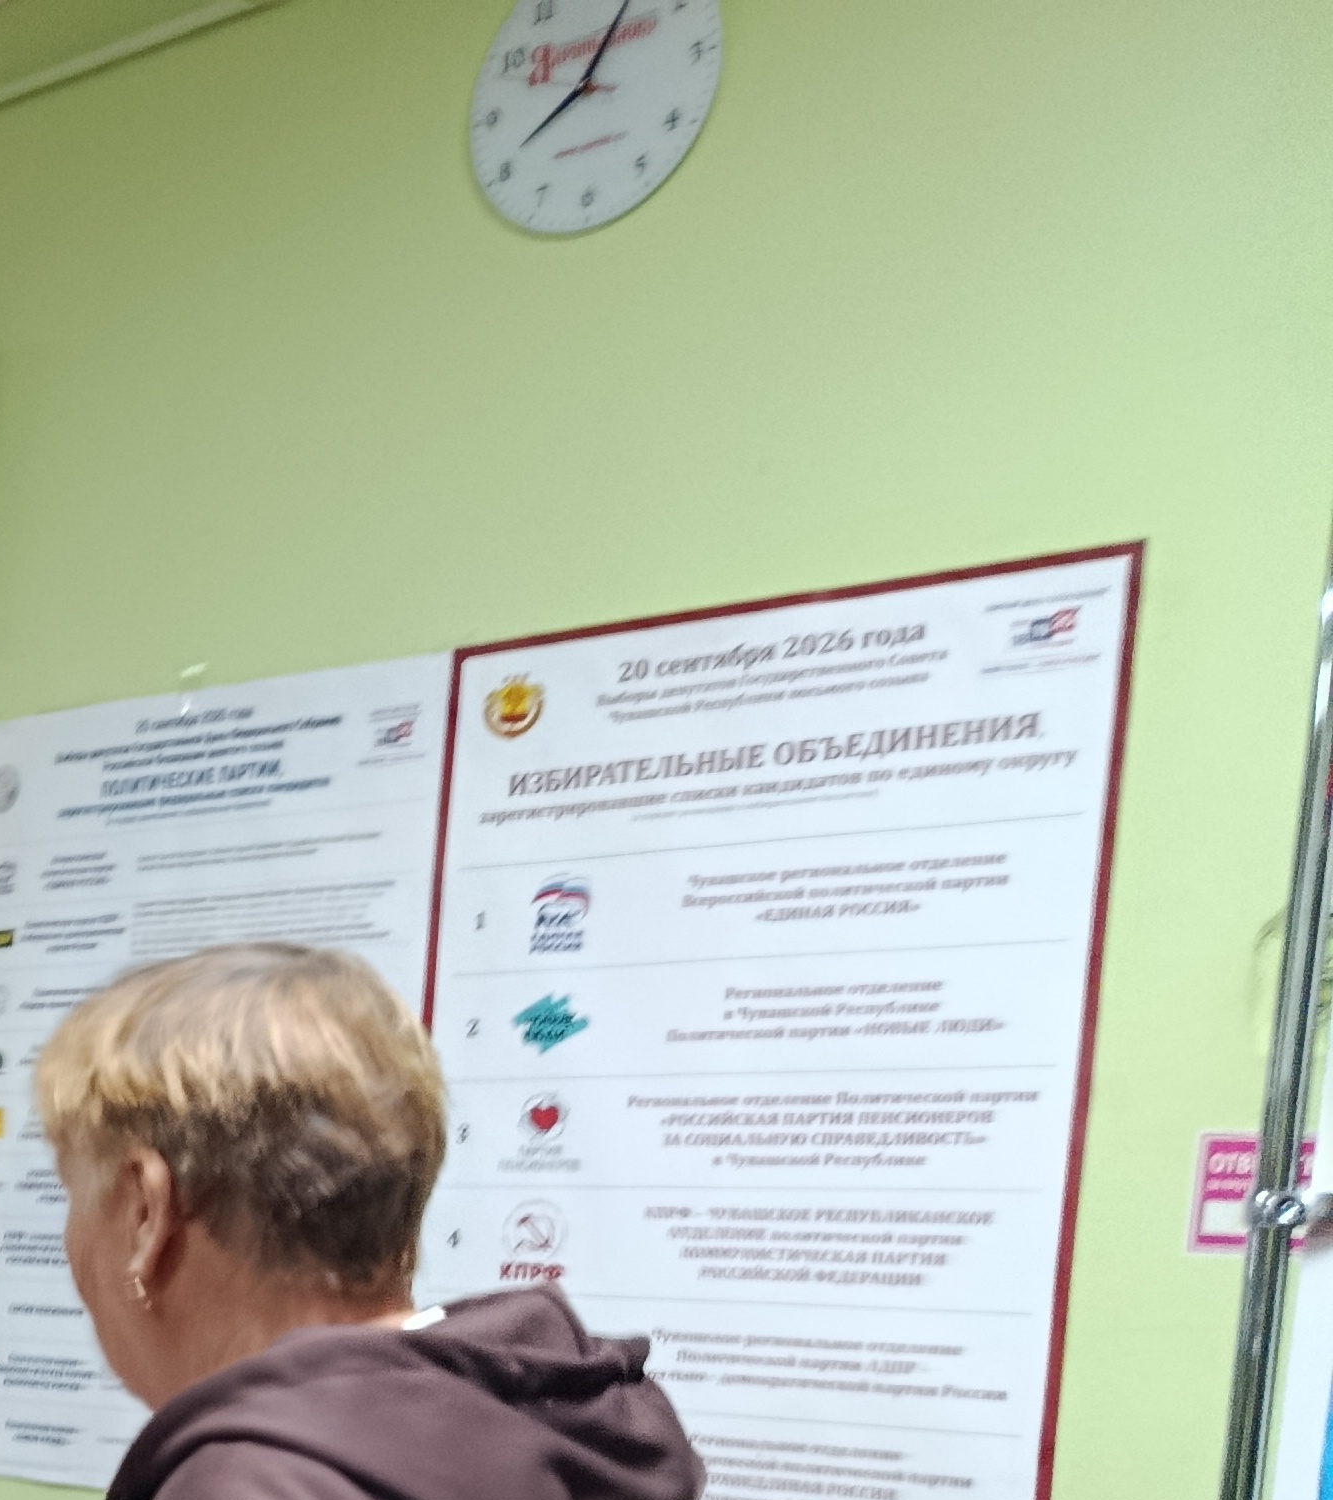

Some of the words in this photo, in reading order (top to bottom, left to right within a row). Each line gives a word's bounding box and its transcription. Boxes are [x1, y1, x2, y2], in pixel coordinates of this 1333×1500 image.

[617, 660, 649, 683] 20
[654, 642, 777, 678] сентября
[782, 628, 854, 660] 2026
[860, 622, 926, 650] года
[507, 743, 768, 797] ИЗБИРАТЕЛЬНЫЕ
[669, 786, 738, 802] списки
[741, 773, 862, 796] кандидатов
[867, 769, 893, 782] по
[897, 758, 994, 782] единому
[474, 910, 486, 930] 1
[465, 1017, 480, 1038] 2
[498, 1261, 566, 1285] КПРФ
